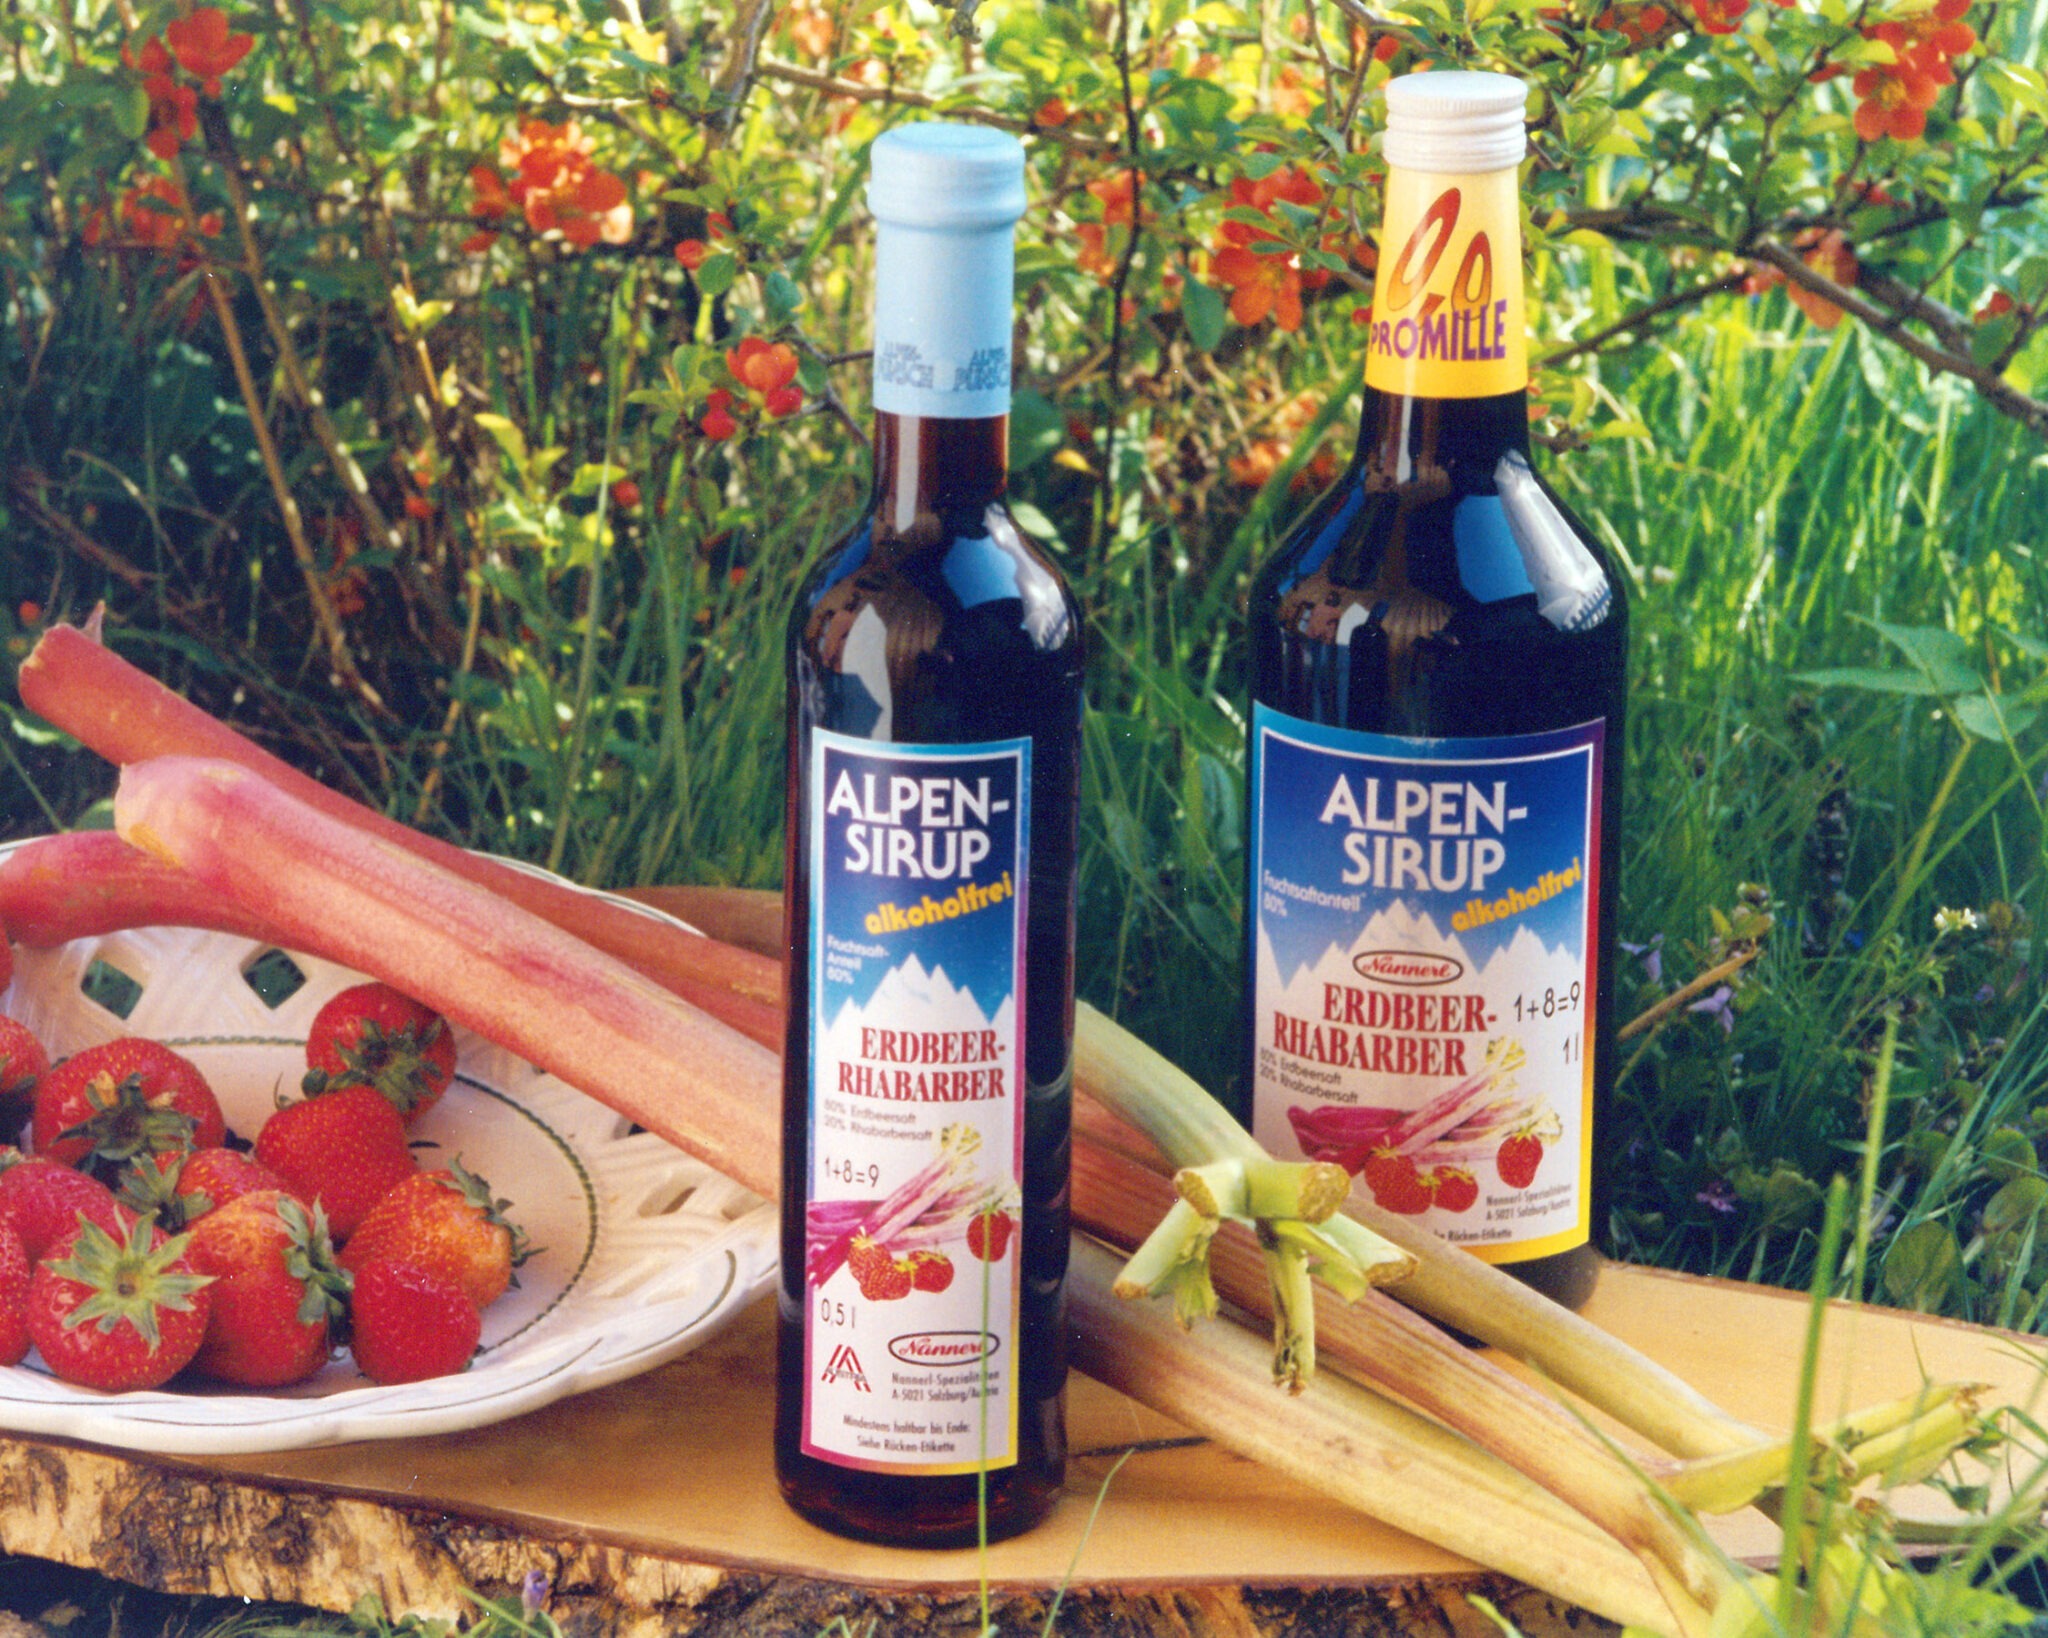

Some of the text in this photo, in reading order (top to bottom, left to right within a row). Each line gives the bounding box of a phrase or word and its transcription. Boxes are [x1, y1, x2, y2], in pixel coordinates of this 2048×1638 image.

[1370, 299, 1507, 362] PROMILLE
[827, 769, 1010, 827] ALPEN-
[1319, 773, 1528, 835] ALPEN-
[845, 824, 990, 879] SIRUP
[1342, 832, 1505, 892] SIRUP
[864, 870, 1014, 935] alkoholfrei
[1451, 856, 1582, 932] alkoholfrei
[1322, 982, 1497, 1034] ERDBEER-
[1514, 980, 1581, 1022] 1+8=9
[860, 1027, 1006, 1064] ERDBEER-
[1272, 1011, 1467, 1077] RHABARBER
[838, 1061, 1006, 1103] RHABARBER
[1281, 1057, 1342, 1085] Erdbeersaft
[1281, 1073, 1359, 1104] Rhabarbersaft
[851, 1105, 916, 1124] Erdbeersaft
[851, 1122, 933, 1141] Rhabarbersaft
[824, 1155, 880, 1188] 1+8=9
[821, 1298, 845, 1326] 0,5
[843, 1414, 889, 1432] Mindestens
[894, 1419, 926, 1434] haltbar
[930, 1421, 943, 1434] bis
